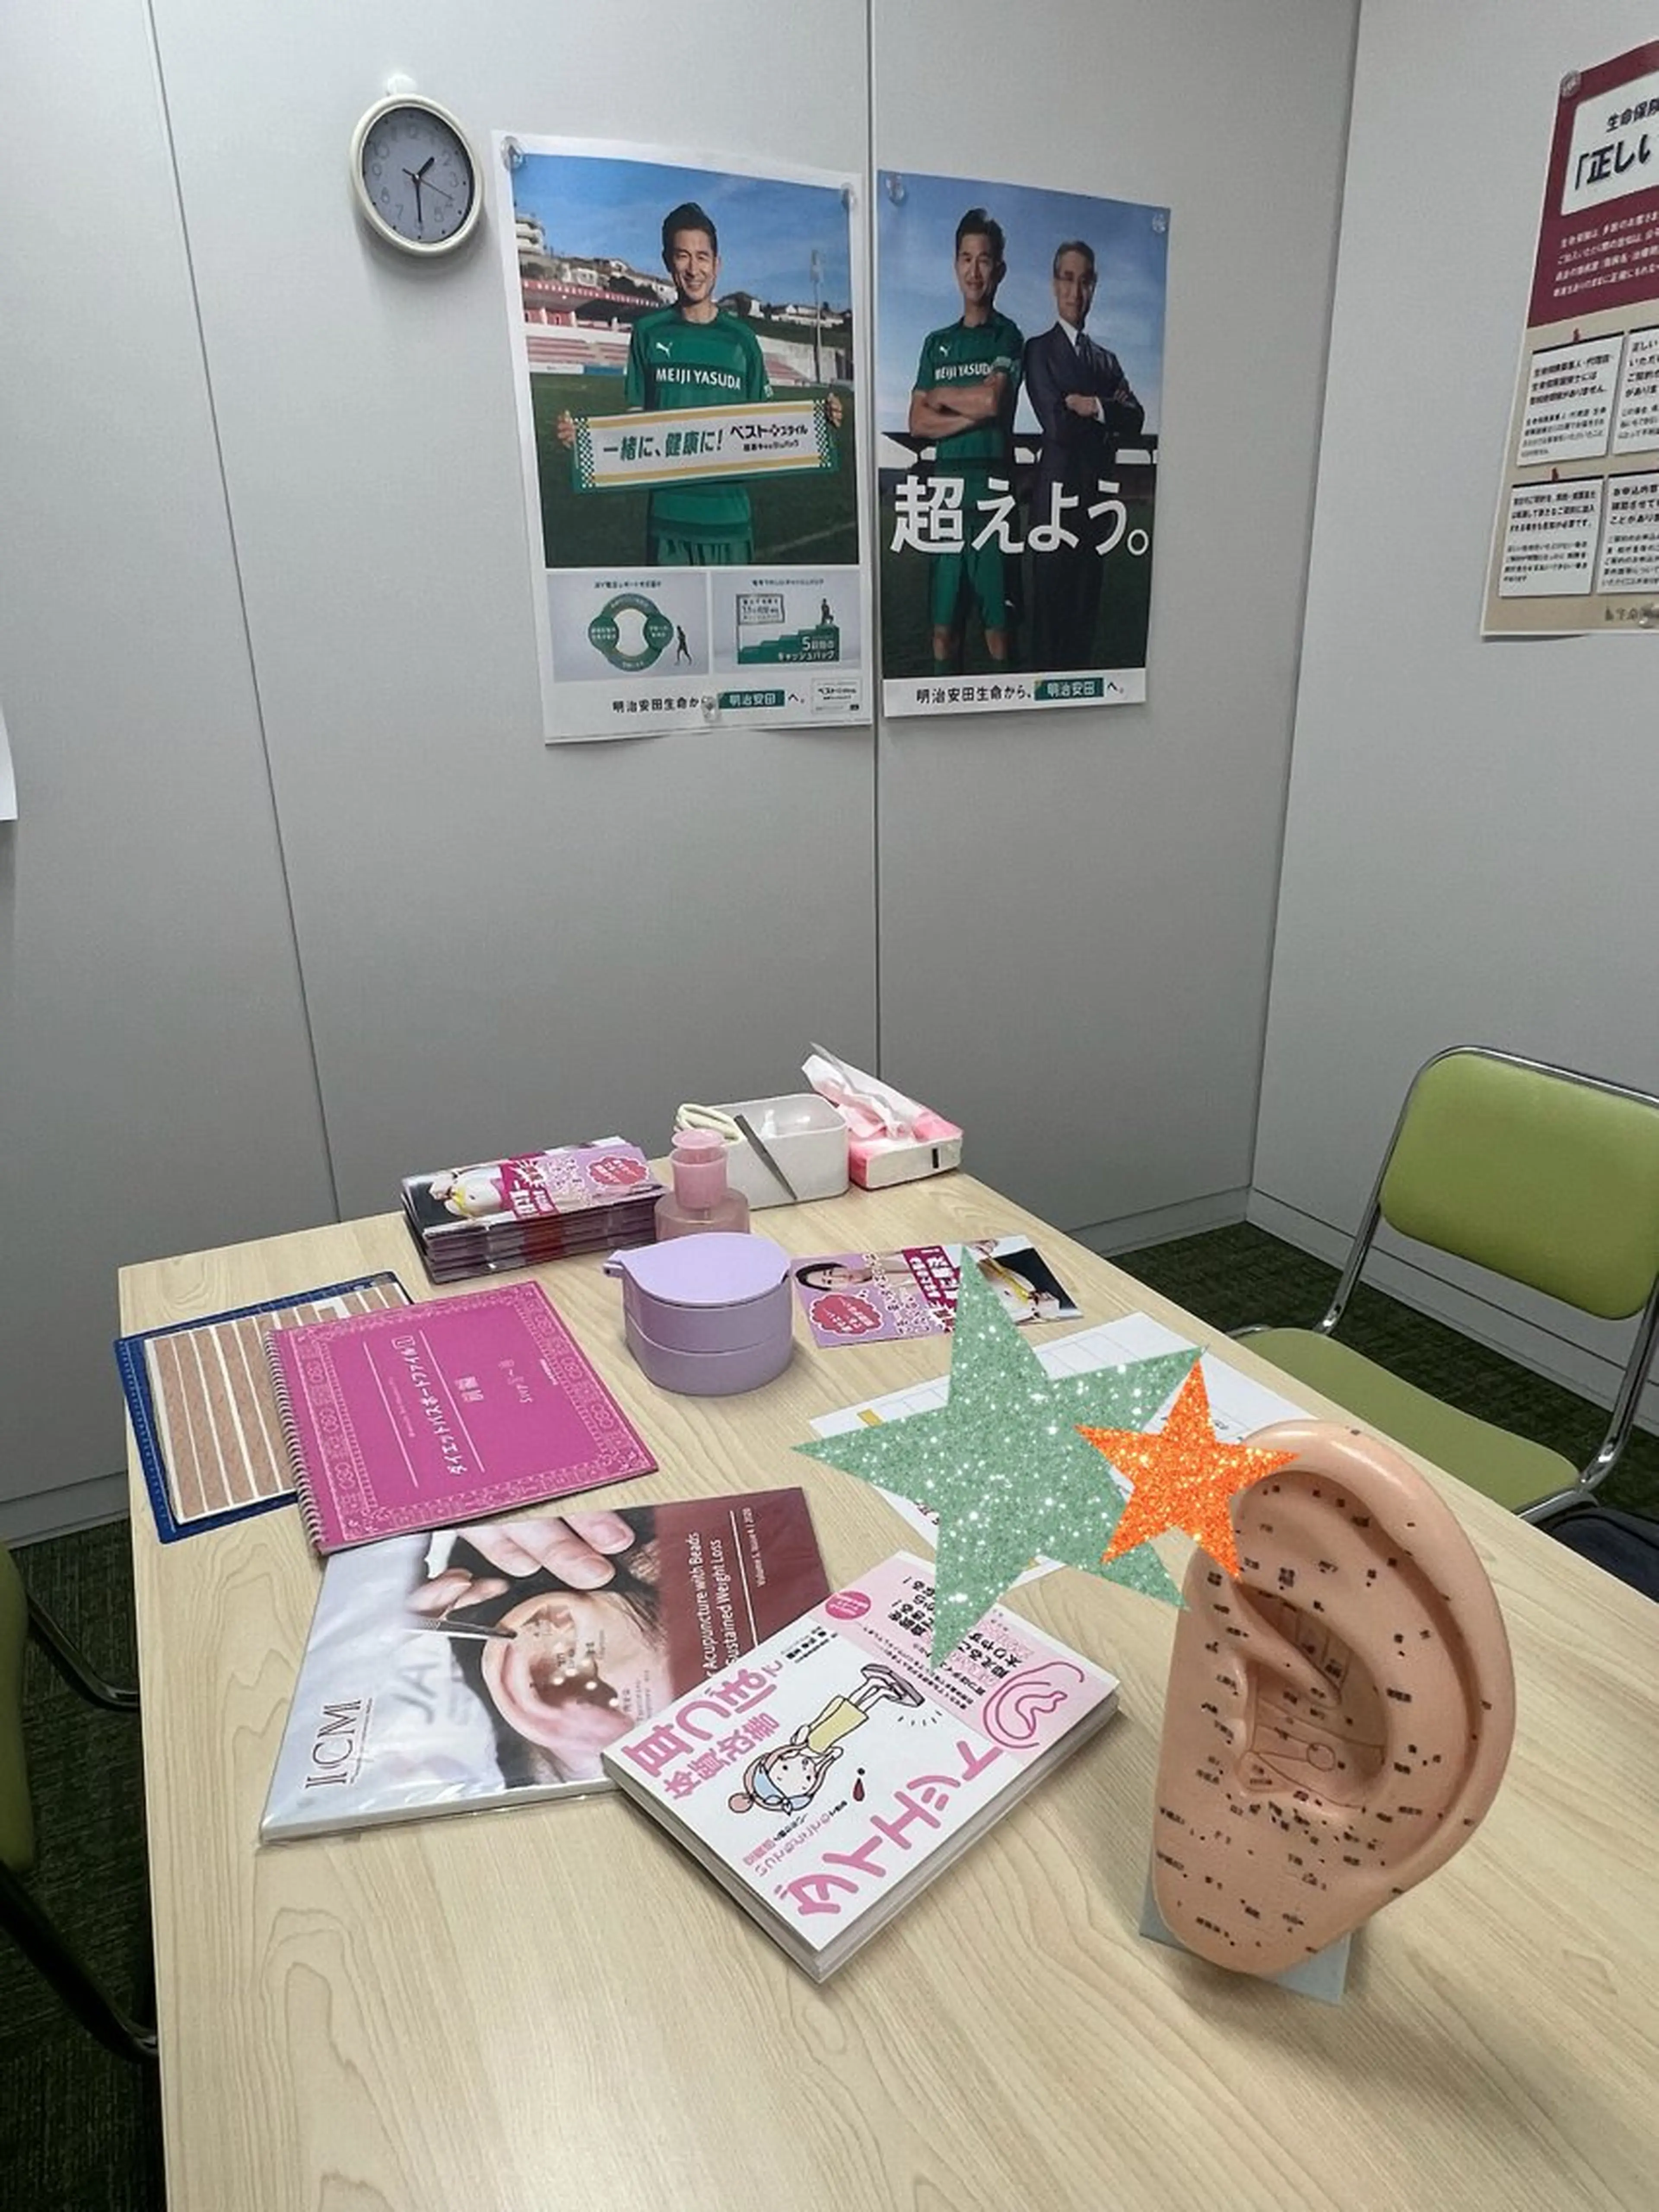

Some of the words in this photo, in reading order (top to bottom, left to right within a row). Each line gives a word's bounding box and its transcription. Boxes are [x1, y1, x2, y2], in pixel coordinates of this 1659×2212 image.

[656, 368, 694, 386] MEIJI
[694, 369, 741, 391] YASUDA
[890, 474, 1150, 556] 超えよう。
[729, 693, 776, 706] 明治安田
[916, 684, 1032, 704] 明治安田生命から、
[1047, 681, 1095, 698] 明治安田
[685, 1532, 703, 1565] Beads
[710, 1538, 724, 1564] Loss
[689, 1566, 707, 1590] with
[711, 1565, 732, 1605] Weight
[696, 1590, 718, 1671] Acupuncture
[716, 1604, 740, 1667] Sustained
[664, 1712, 781, 1800] 体質改善
[774, 1740, 1004, 1916] ダイエット
